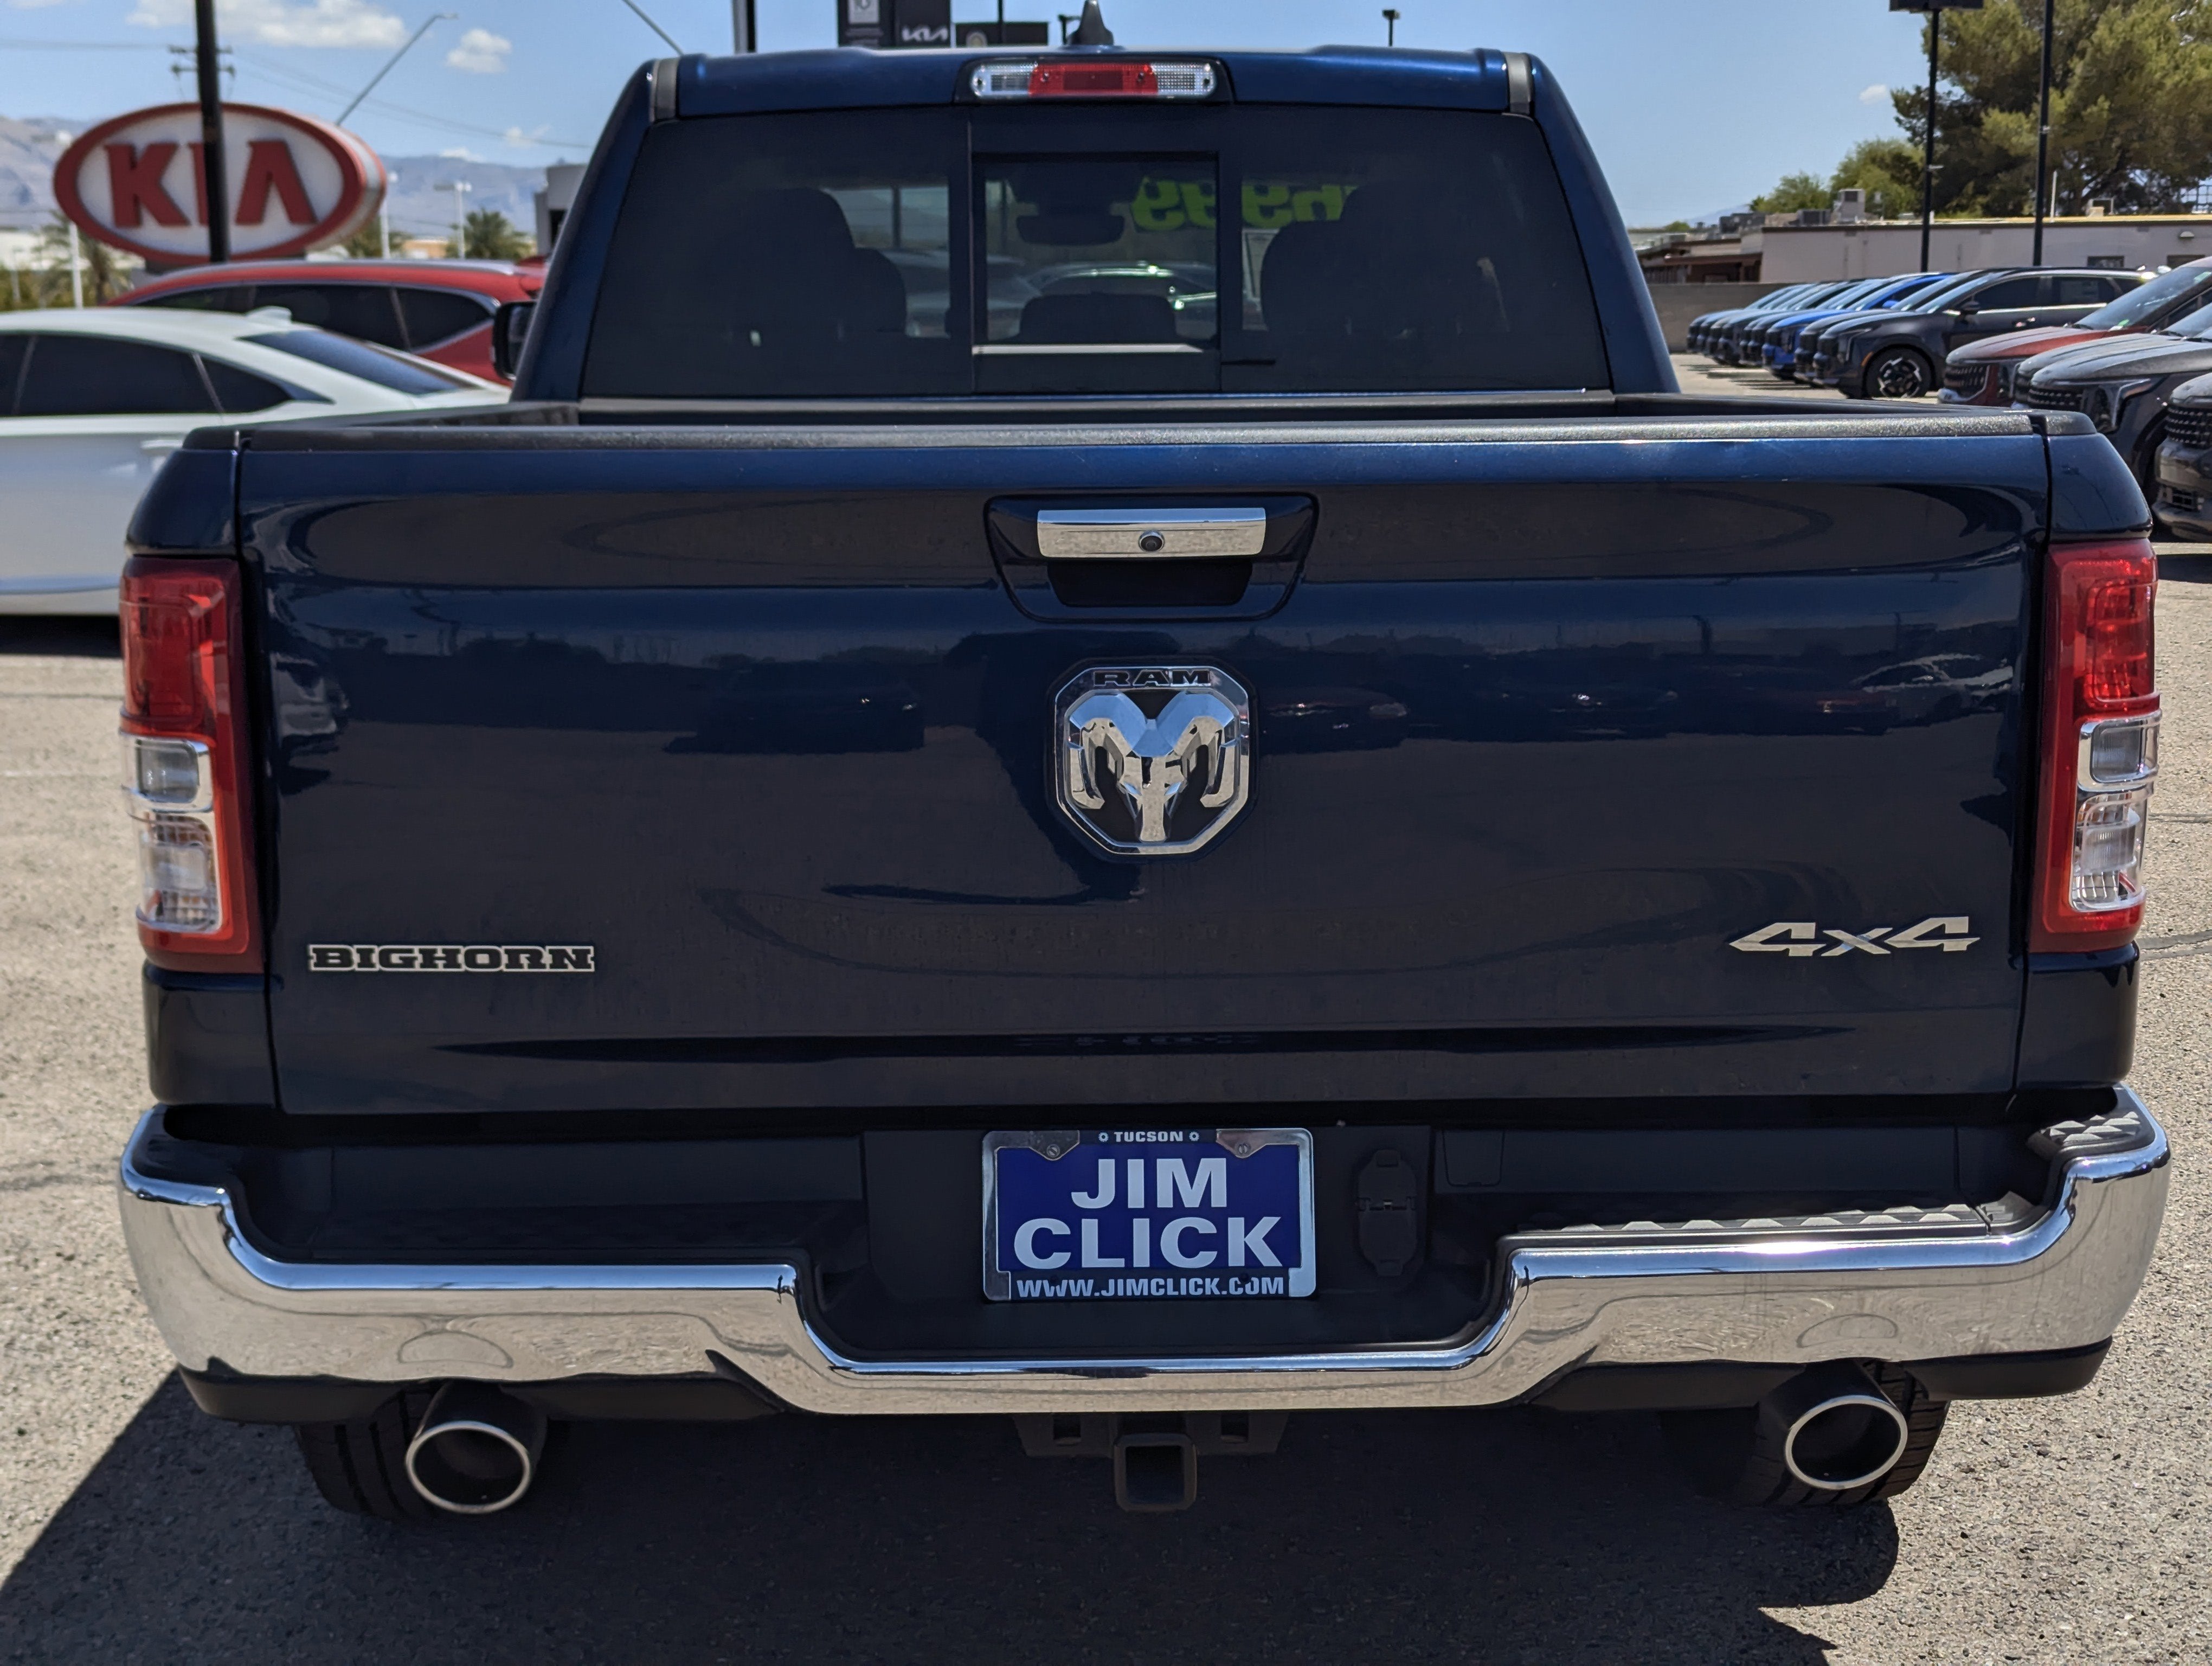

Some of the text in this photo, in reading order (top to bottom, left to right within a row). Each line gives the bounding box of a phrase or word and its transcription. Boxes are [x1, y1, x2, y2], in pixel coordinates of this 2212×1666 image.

[1093, 669, 1211, 687] RAM
[308, 944, 595, 972] BIGHORN
[1114, 1131, 1184, 1143] TUCSON
[1071, 1157, 1227, 1209] JIM
[1013, 1216, 1283, 1270] CLICK
[1017, 1277, 1284, 1298] WWW.JIMCLICK.COM
